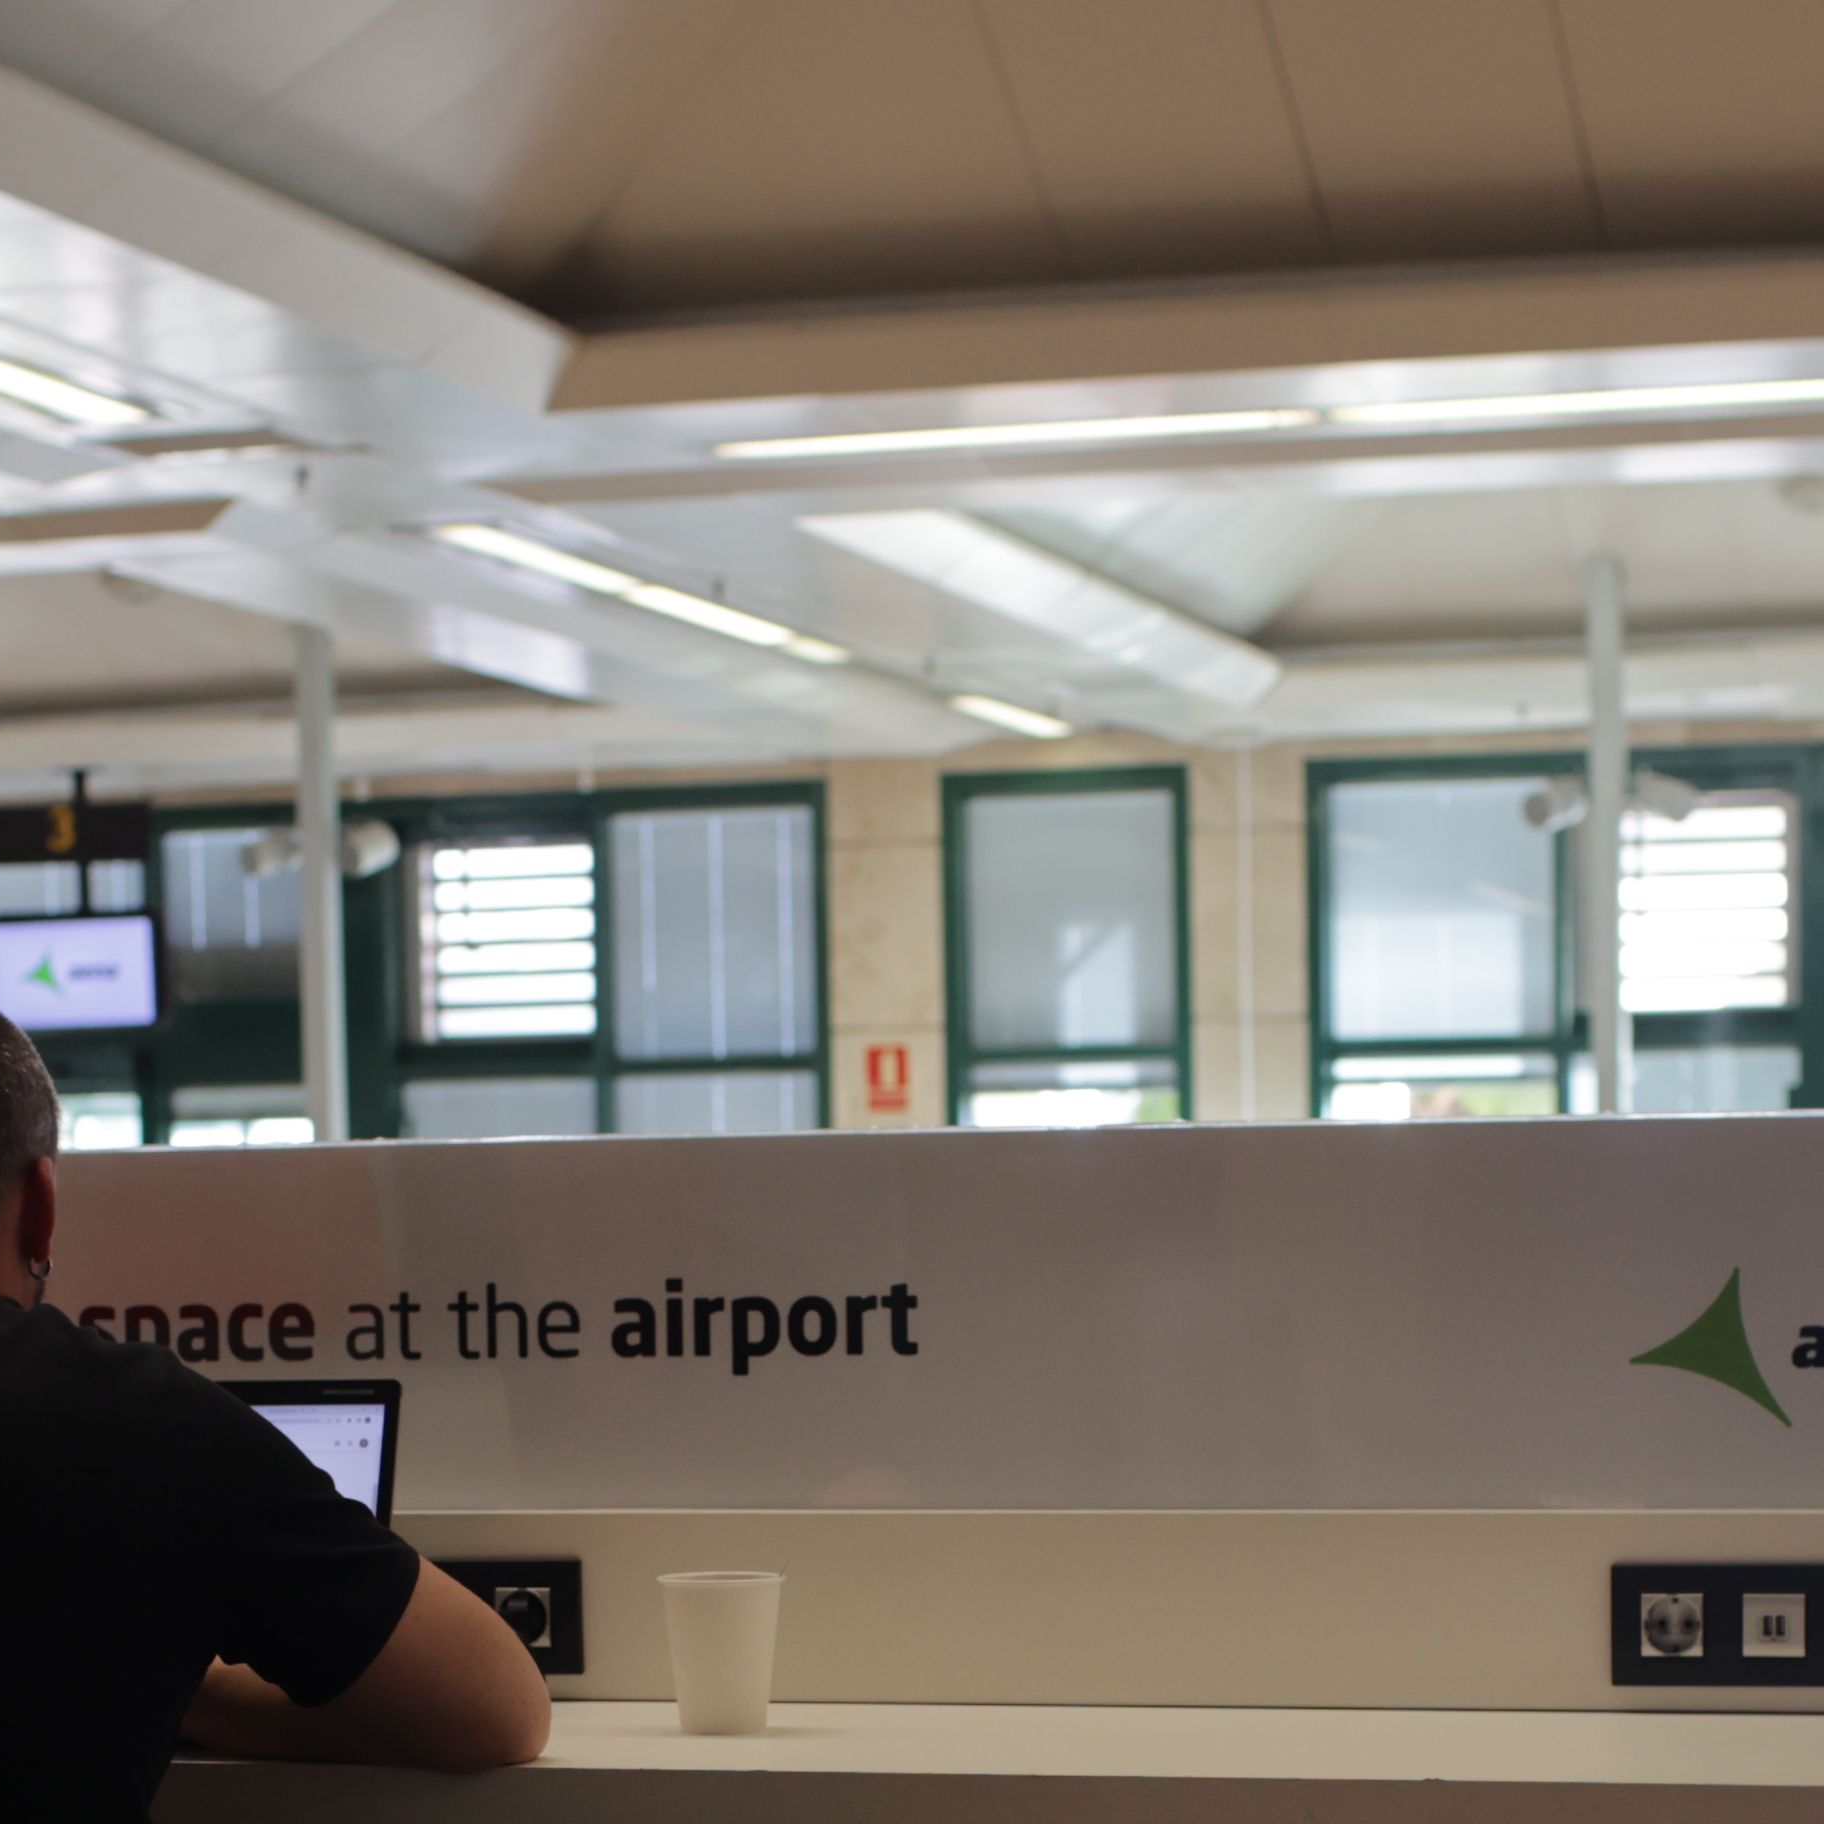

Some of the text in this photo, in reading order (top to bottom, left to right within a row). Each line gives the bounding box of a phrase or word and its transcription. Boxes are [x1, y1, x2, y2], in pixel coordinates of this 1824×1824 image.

[46, 803, 75, 851] 3
[346, 1291, 422, 1361] at
[447, 1281, 581, 1361] the
[611, 1277, 919, 1377] airport
